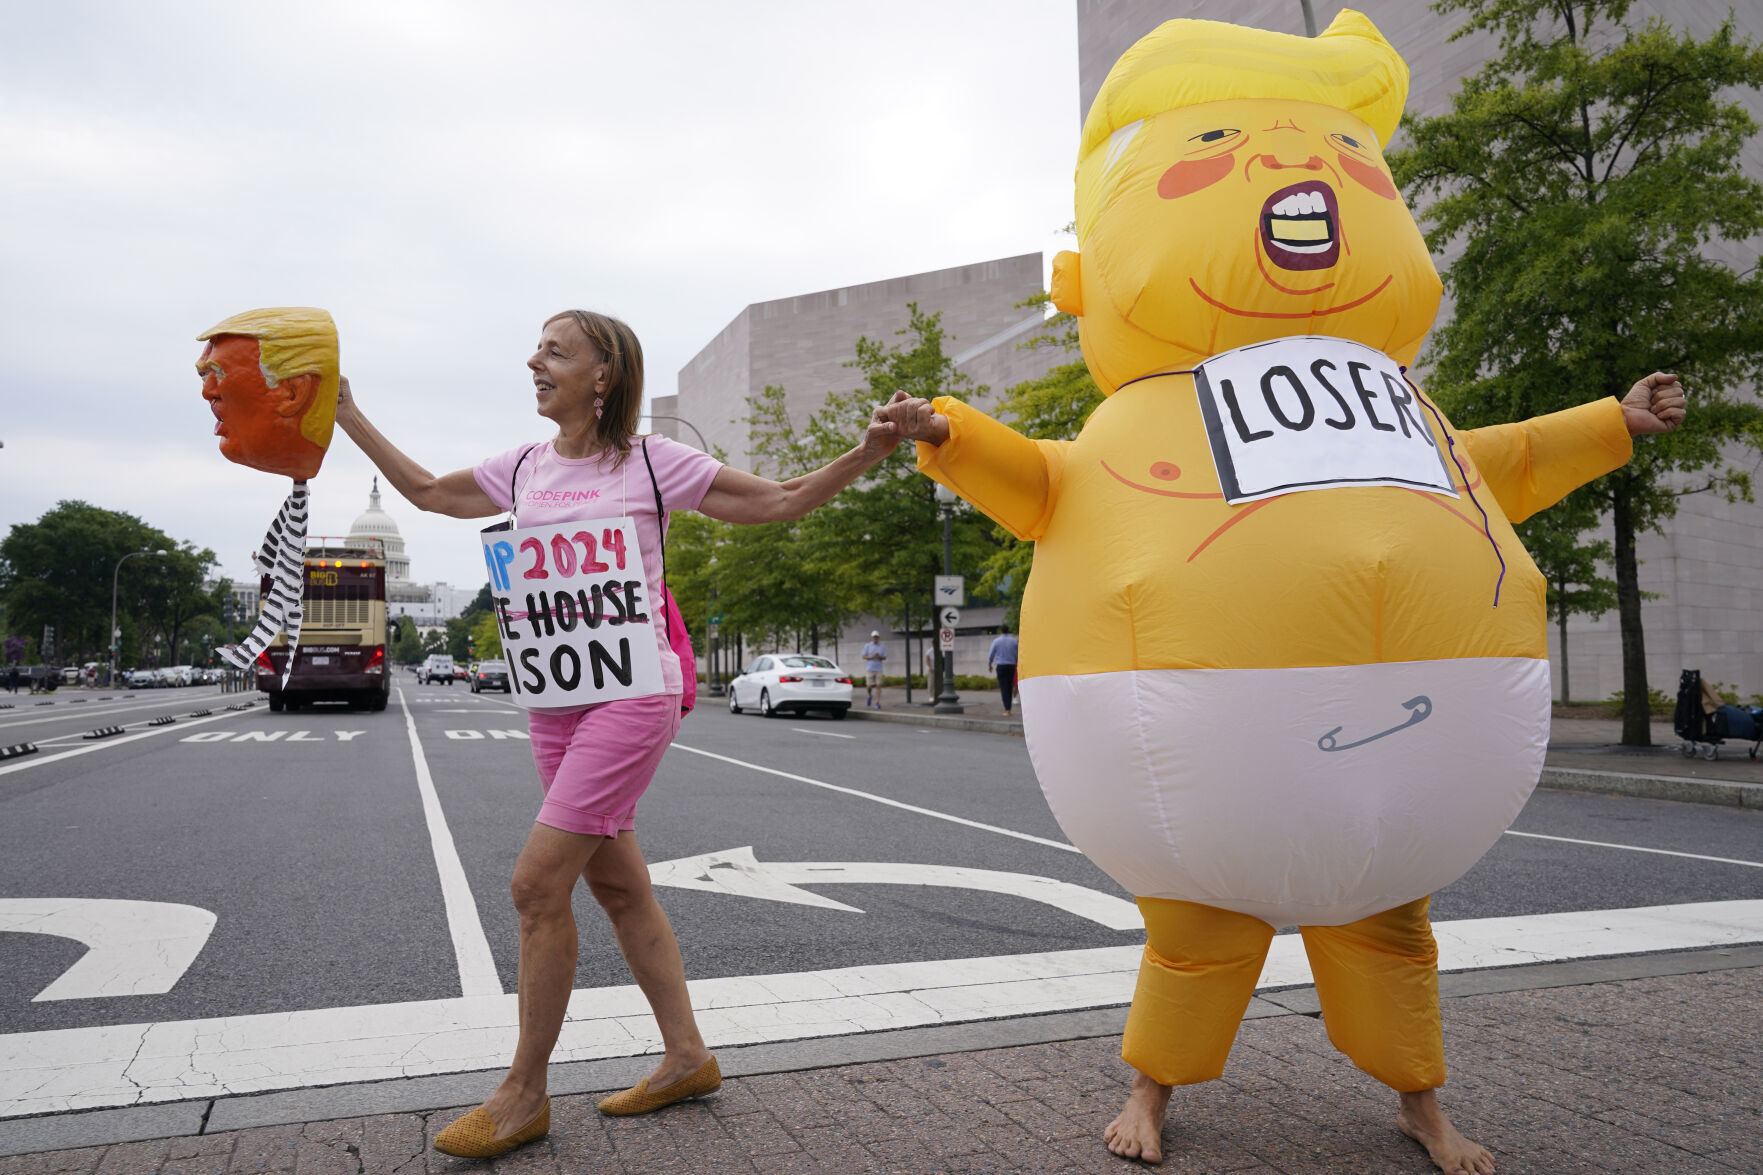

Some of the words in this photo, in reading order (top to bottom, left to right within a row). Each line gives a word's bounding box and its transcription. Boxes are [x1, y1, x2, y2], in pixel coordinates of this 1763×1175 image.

[1220, 358, 1435, 447] LOSER
[526, 488, 601, 501] CODEPINK
[519, 528, 627, 579] 2024
[526, 579, 647, 638] HOUSE
[178, 730, 368, 742] ONLY
